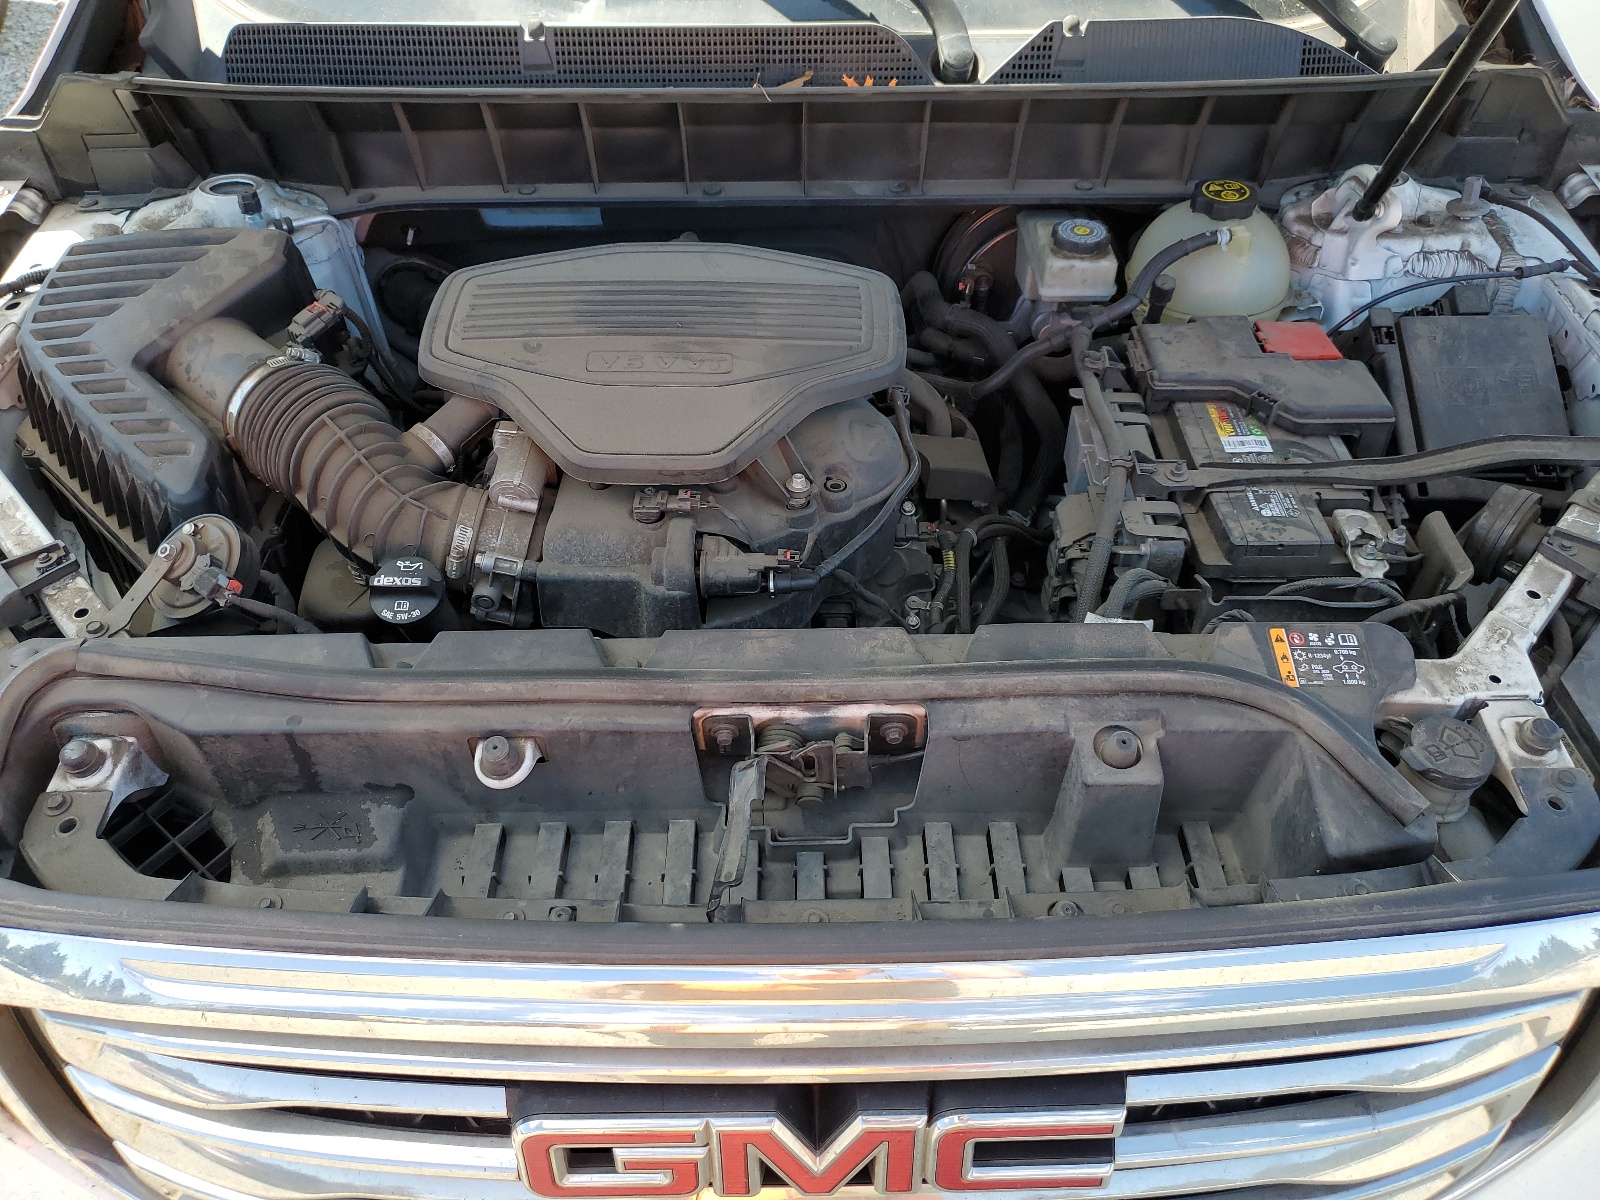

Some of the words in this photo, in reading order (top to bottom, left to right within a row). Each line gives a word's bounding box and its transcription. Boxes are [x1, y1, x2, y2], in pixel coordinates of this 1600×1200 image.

[652, 355, 728, 370] VVT
[373, 574, 422, 586] dexos
[381, 609, 394, 619] SAE
[396, 609, 421, 620] 5W-30
[511, 1111, 1127, 1198] GMC
